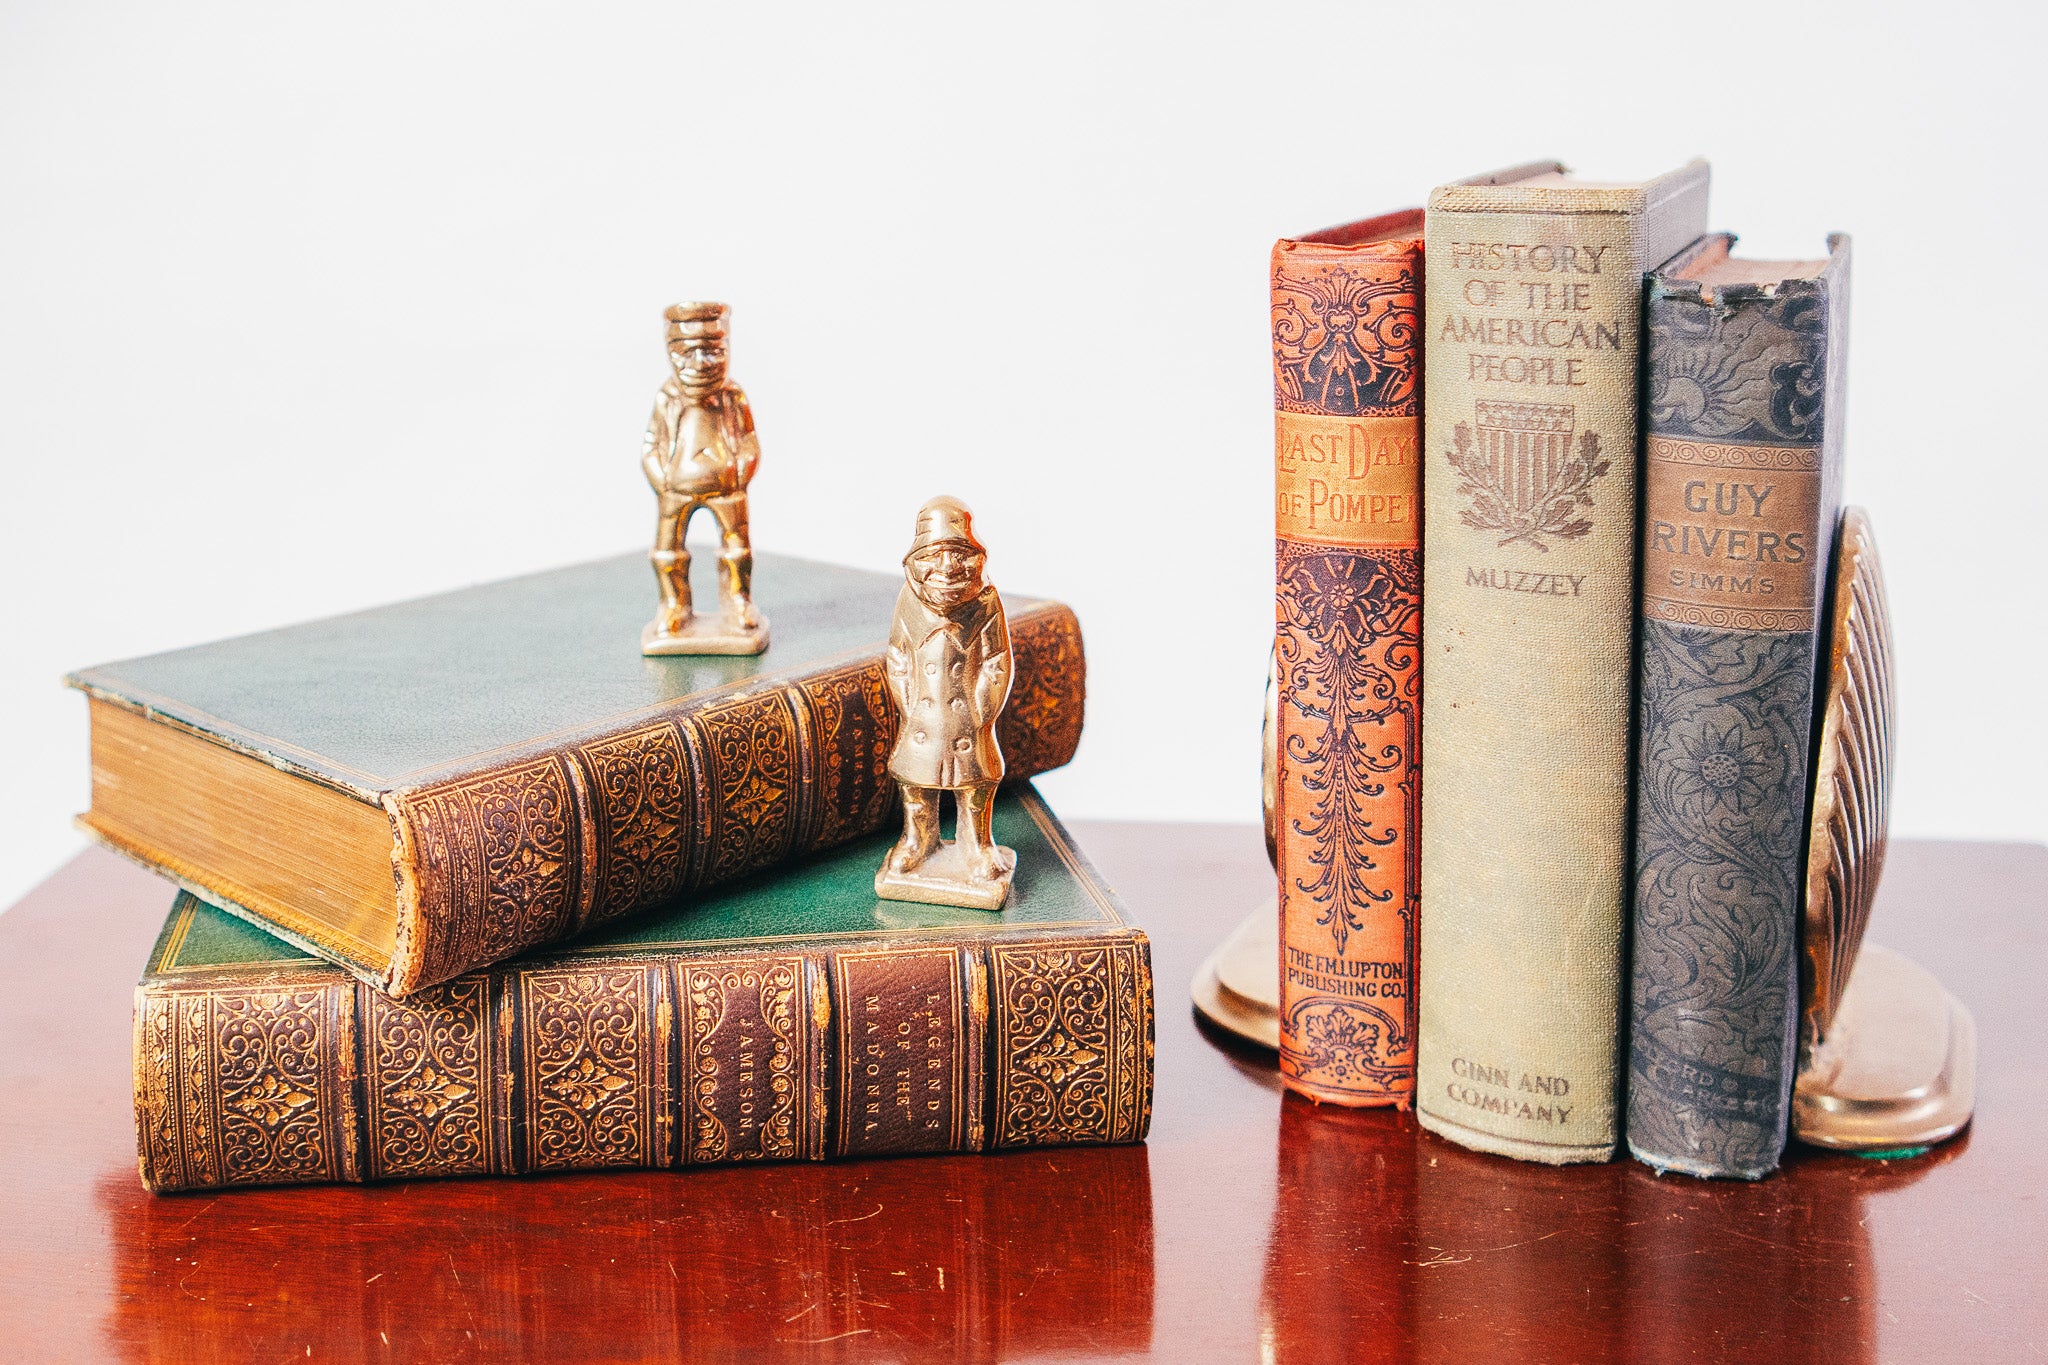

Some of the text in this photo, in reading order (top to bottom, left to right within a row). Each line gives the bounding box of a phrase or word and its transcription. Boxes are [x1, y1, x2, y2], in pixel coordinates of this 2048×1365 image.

[1451, 242, 1611, 275] HISTORY
[1463, 279, 1592, 310] OF THE
[1440, 315, 1621, 351] AMERICAN
[1467, 353, 1587, 386] PEOPLE
[1279, 417, 1343, 474] LAST
[1279, 492, 1305, 518] OF
[1684, 480, 1776, 518] GUY
[1651, 520, 1806, 564] RIVERS
[1465, 566, 1587, 597] MUZZEY
[1669, 568, 1776, 595] SIMMS
[1287, 946, 1313, 970] THE
[1287, 966, 1406, 999] PUBLISHING CO.
[896, 1021, 912, 1109] OF THE
[926, 993, 942, 1131] LEGENDS
[1451, 1057, 1570, 1097] GINN AND
[1446, 1082, 1574, 1125] COMPANY
